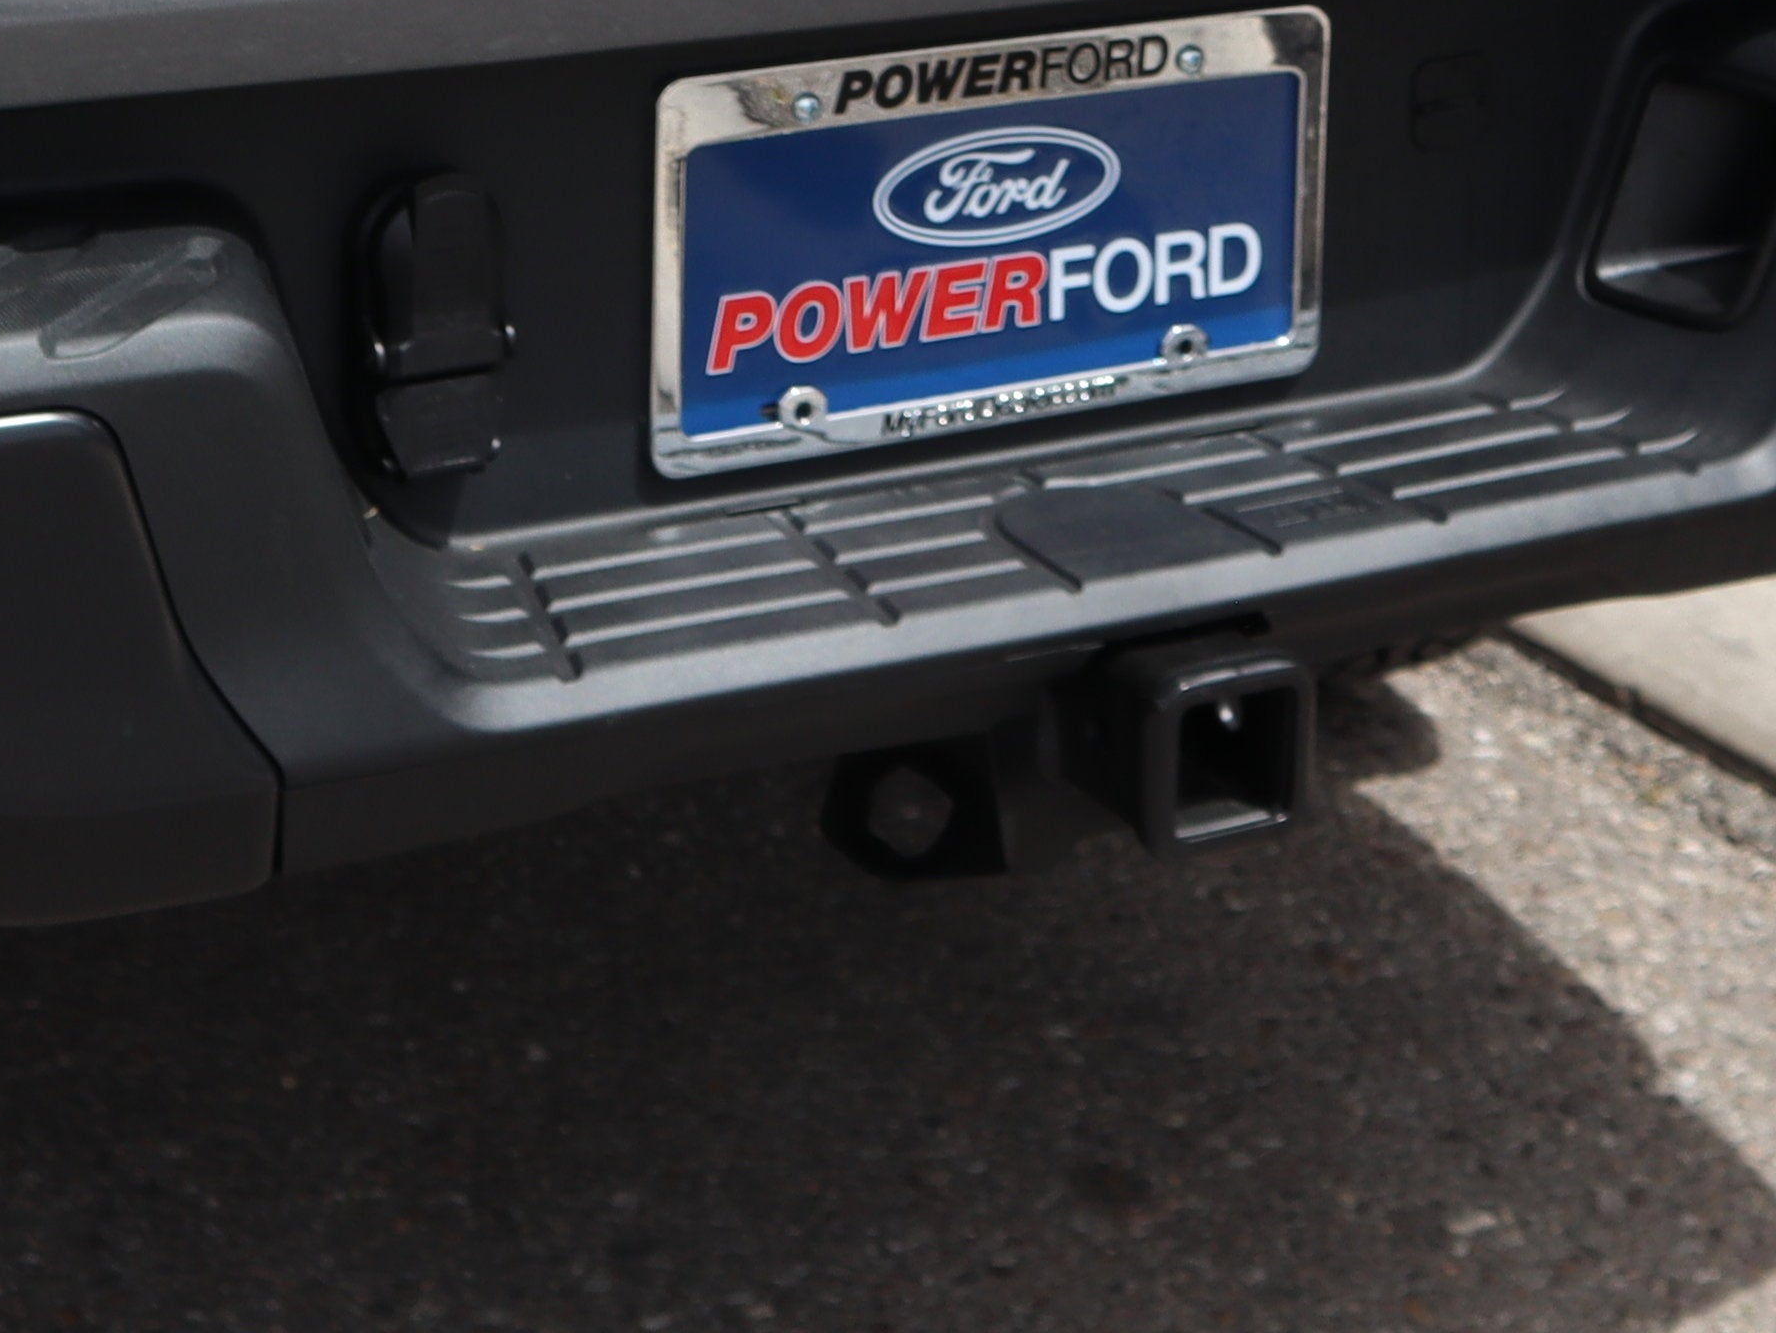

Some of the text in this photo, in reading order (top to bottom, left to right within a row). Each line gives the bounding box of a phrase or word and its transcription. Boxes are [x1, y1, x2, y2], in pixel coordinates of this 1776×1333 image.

[833, 34, 1169, 115] POWERFORD
[923, 148, 1071, 224] Ford
[705, 222, 1263, 376] POWERFORD
